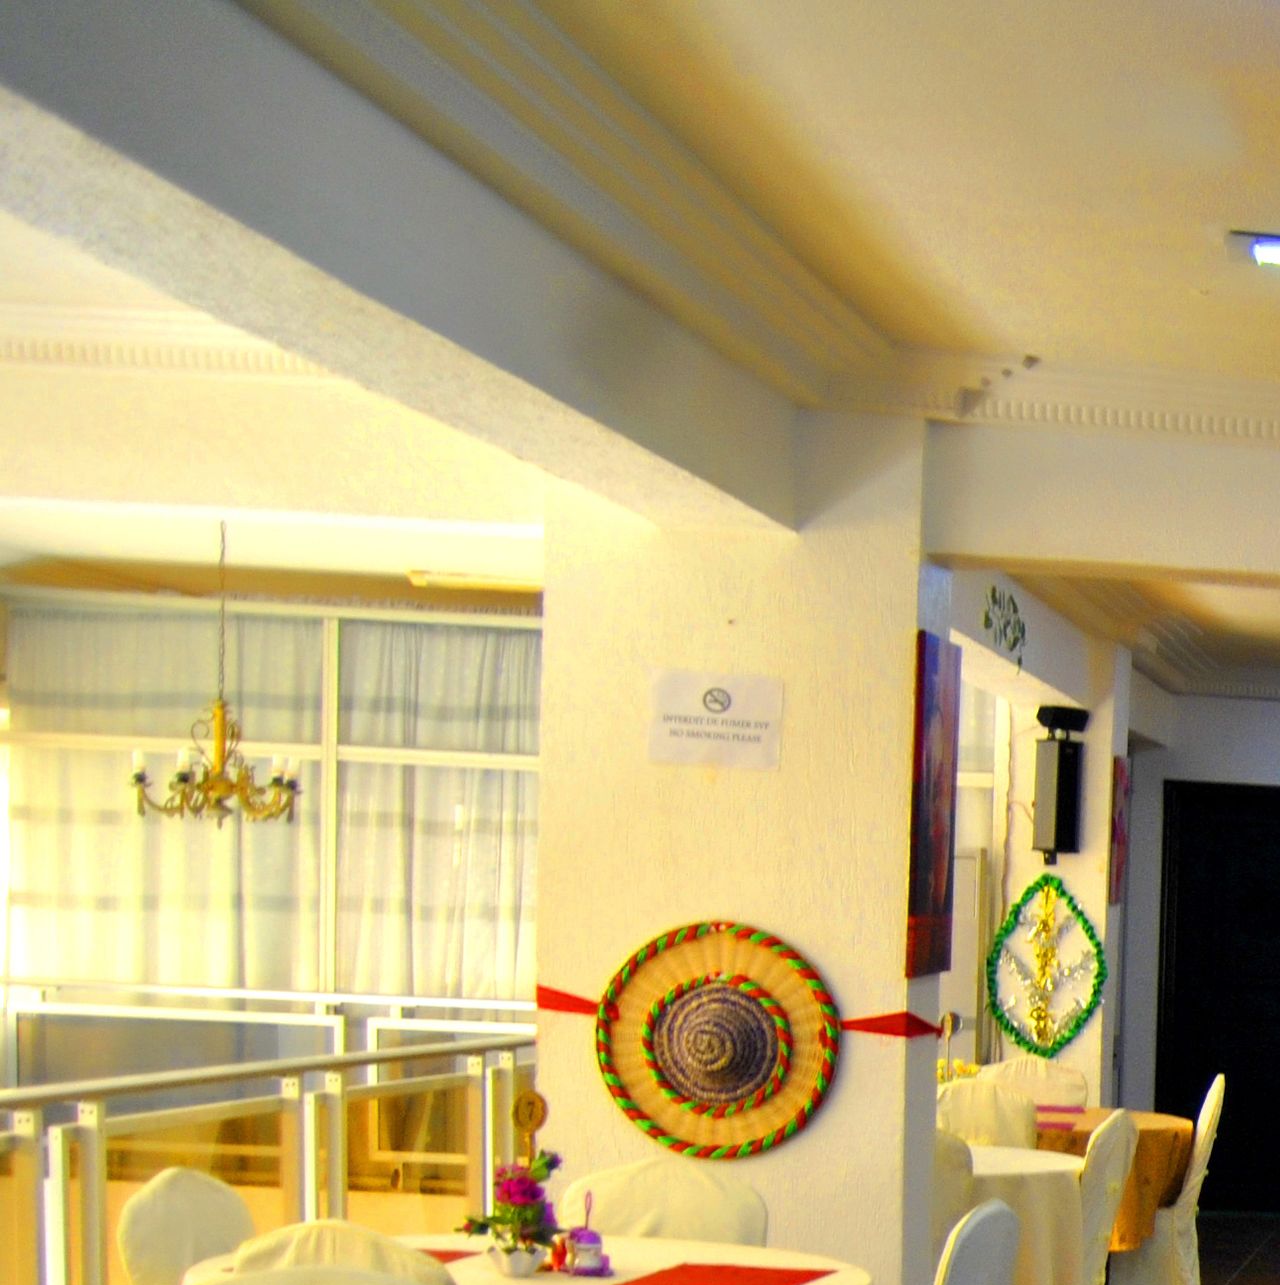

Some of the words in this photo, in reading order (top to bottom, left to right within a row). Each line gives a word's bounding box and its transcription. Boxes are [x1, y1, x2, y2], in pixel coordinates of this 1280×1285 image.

[721, 718, 752, 729] FUMER
[669, 729, 684, 738] NO
[685, 730, 730, 741] SMOKING
